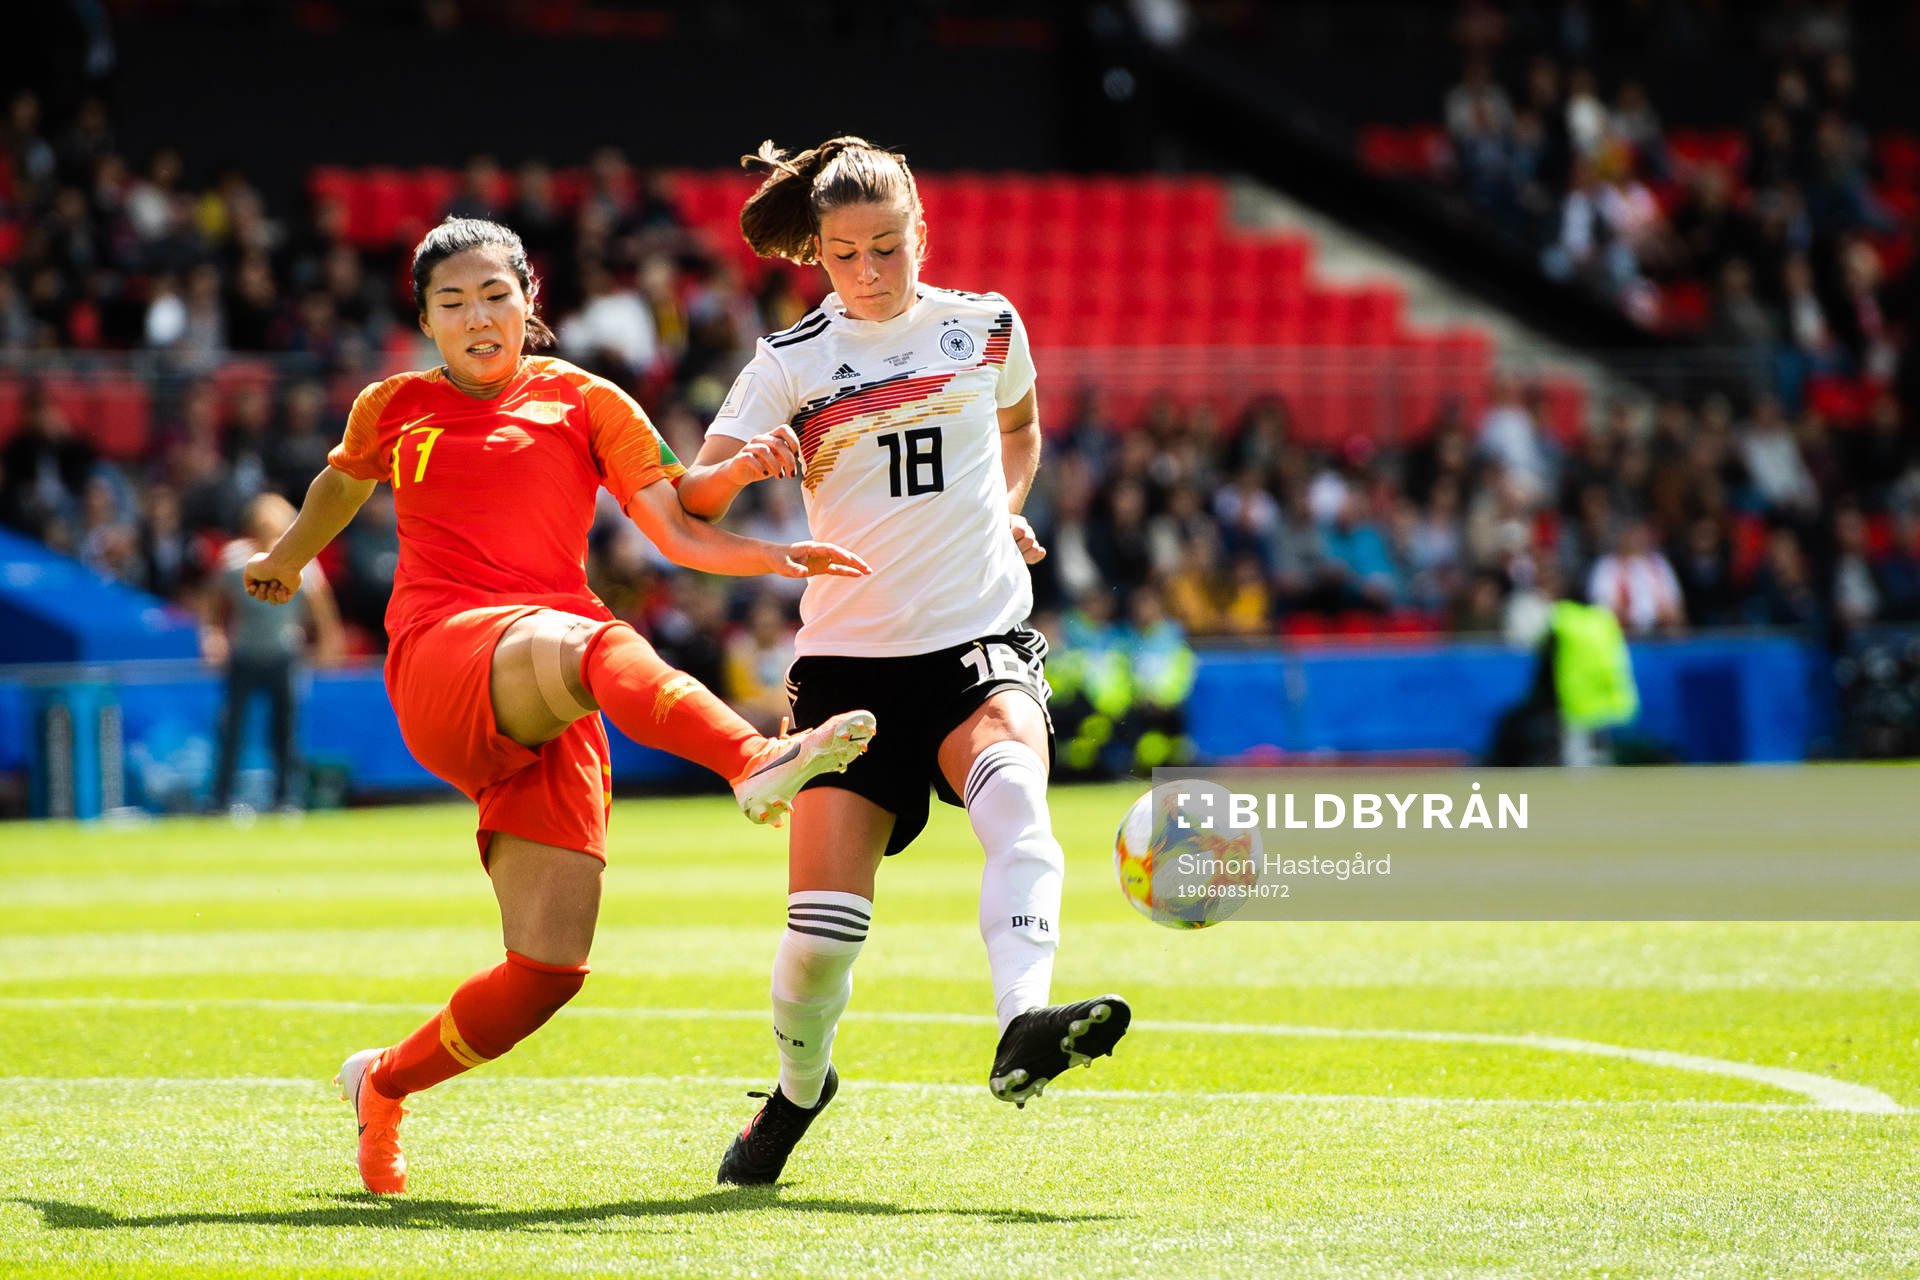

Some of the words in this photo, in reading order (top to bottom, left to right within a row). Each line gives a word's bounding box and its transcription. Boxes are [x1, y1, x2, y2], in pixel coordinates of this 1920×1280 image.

[831, 372, 861, 380] adidas
[392, 426, 445, 489] 17
[877, 426, 944, 498] 18
[960, 643, 1029, 686] 18
[1012, 915, 1049, 932] DFB
